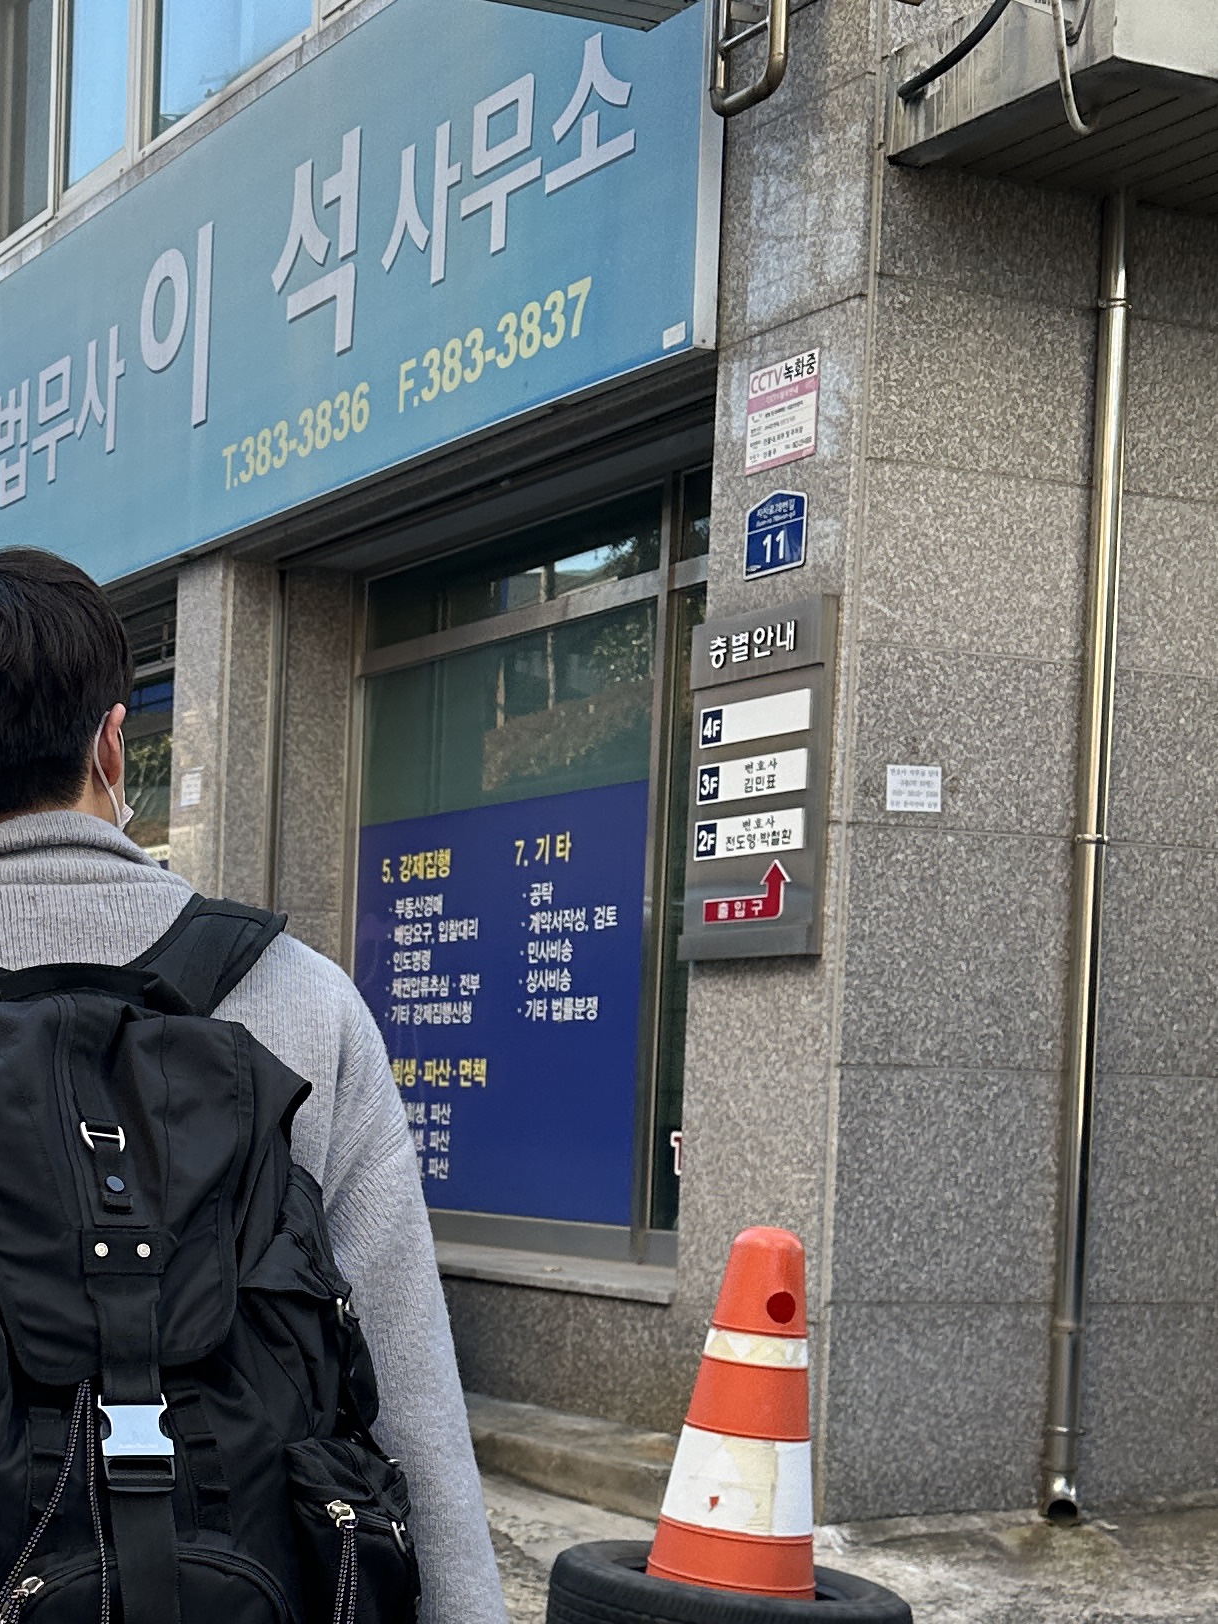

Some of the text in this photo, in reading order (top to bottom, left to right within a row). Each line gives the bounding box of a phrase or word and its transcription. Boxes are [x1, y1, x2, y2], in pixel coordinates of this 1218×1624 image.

[141, 221, 215, 427] 이
[272, 126, 363, 356] 석
[382, 32, 636, 286] 사무소
[223, 277, 593, 491] T.383-3836 F.383-3837
[763, 529, 785, 563] 11
[709, 619, 796, 669] 층별안내
[703, 717, 722, 739] 4F
[700, 774, 719, 796] 3F
[515, 840, 528, 867] 7.
[697, 830, 716, 852] 2F
[382, 848, 451, 884] 5. 강제집행
[394, 893, 443, 920] 부동산경매
[529, 881, 553, 907] 공탁
[438, 917, 479, 943] 입찰대리
[593, 905, 618, 930] 검토
[527, 938, 573, 964] 민사비송
[459, 973, 481, 997] 전부
[526, 967, 572, 994] 상사비송
[391, 1001, 472, 1026] 기타 강제집행신청
[525, 995, 599, 1022] 기타 법률분쟁
[430, 1102, 451, 1125] 파산
[429, 1129, 450, 1152] 파산
[428, 1157, 449, 1179] 파산
